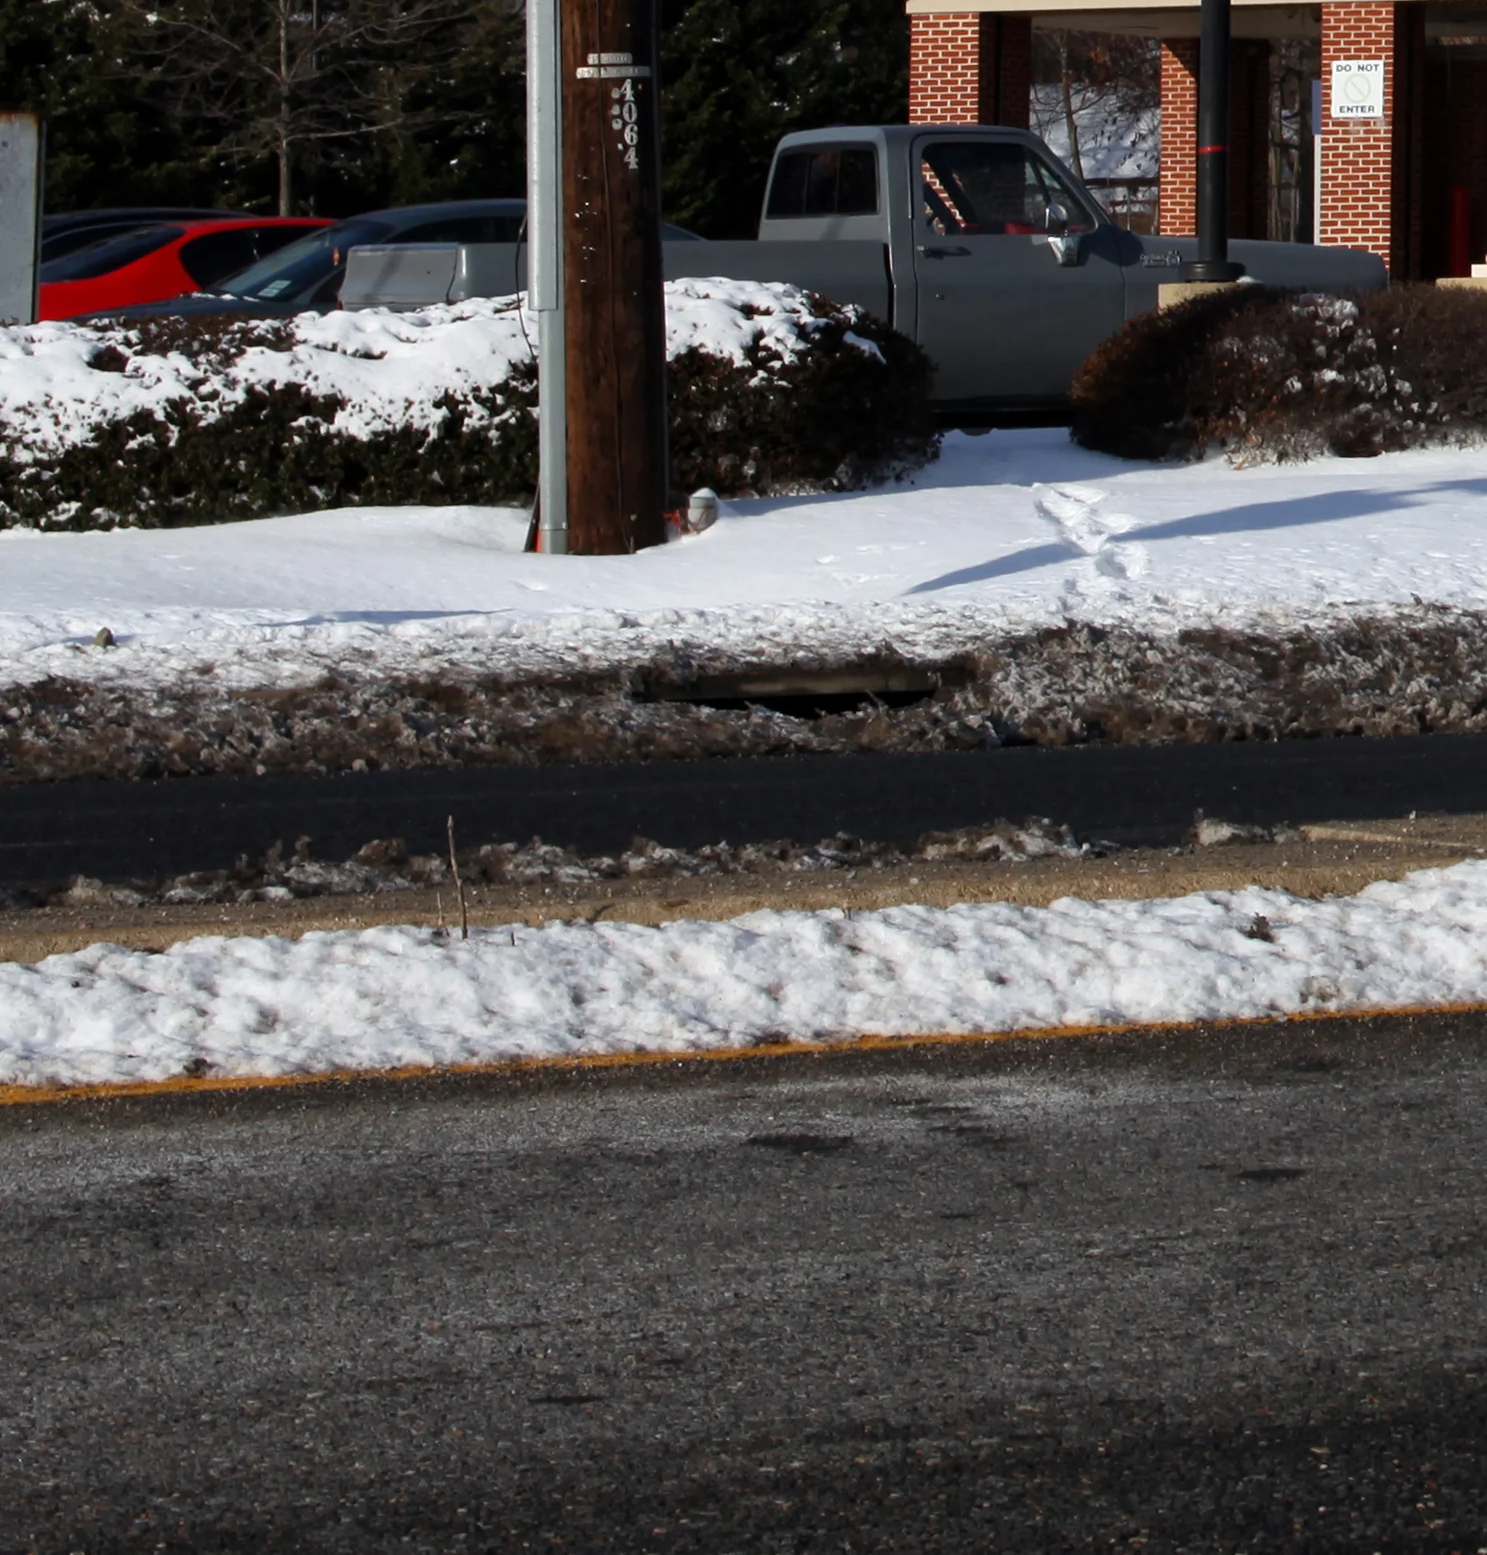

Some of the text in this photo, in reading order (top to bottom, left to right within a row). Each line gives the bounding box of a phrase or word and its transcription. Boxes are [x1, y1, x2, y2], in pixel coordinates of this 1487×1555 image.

[1336, 64, 1379, 72] DO NOT
[1339, 105, 1375, 113] ENTER
[620, 78, 639, 169] 4064
